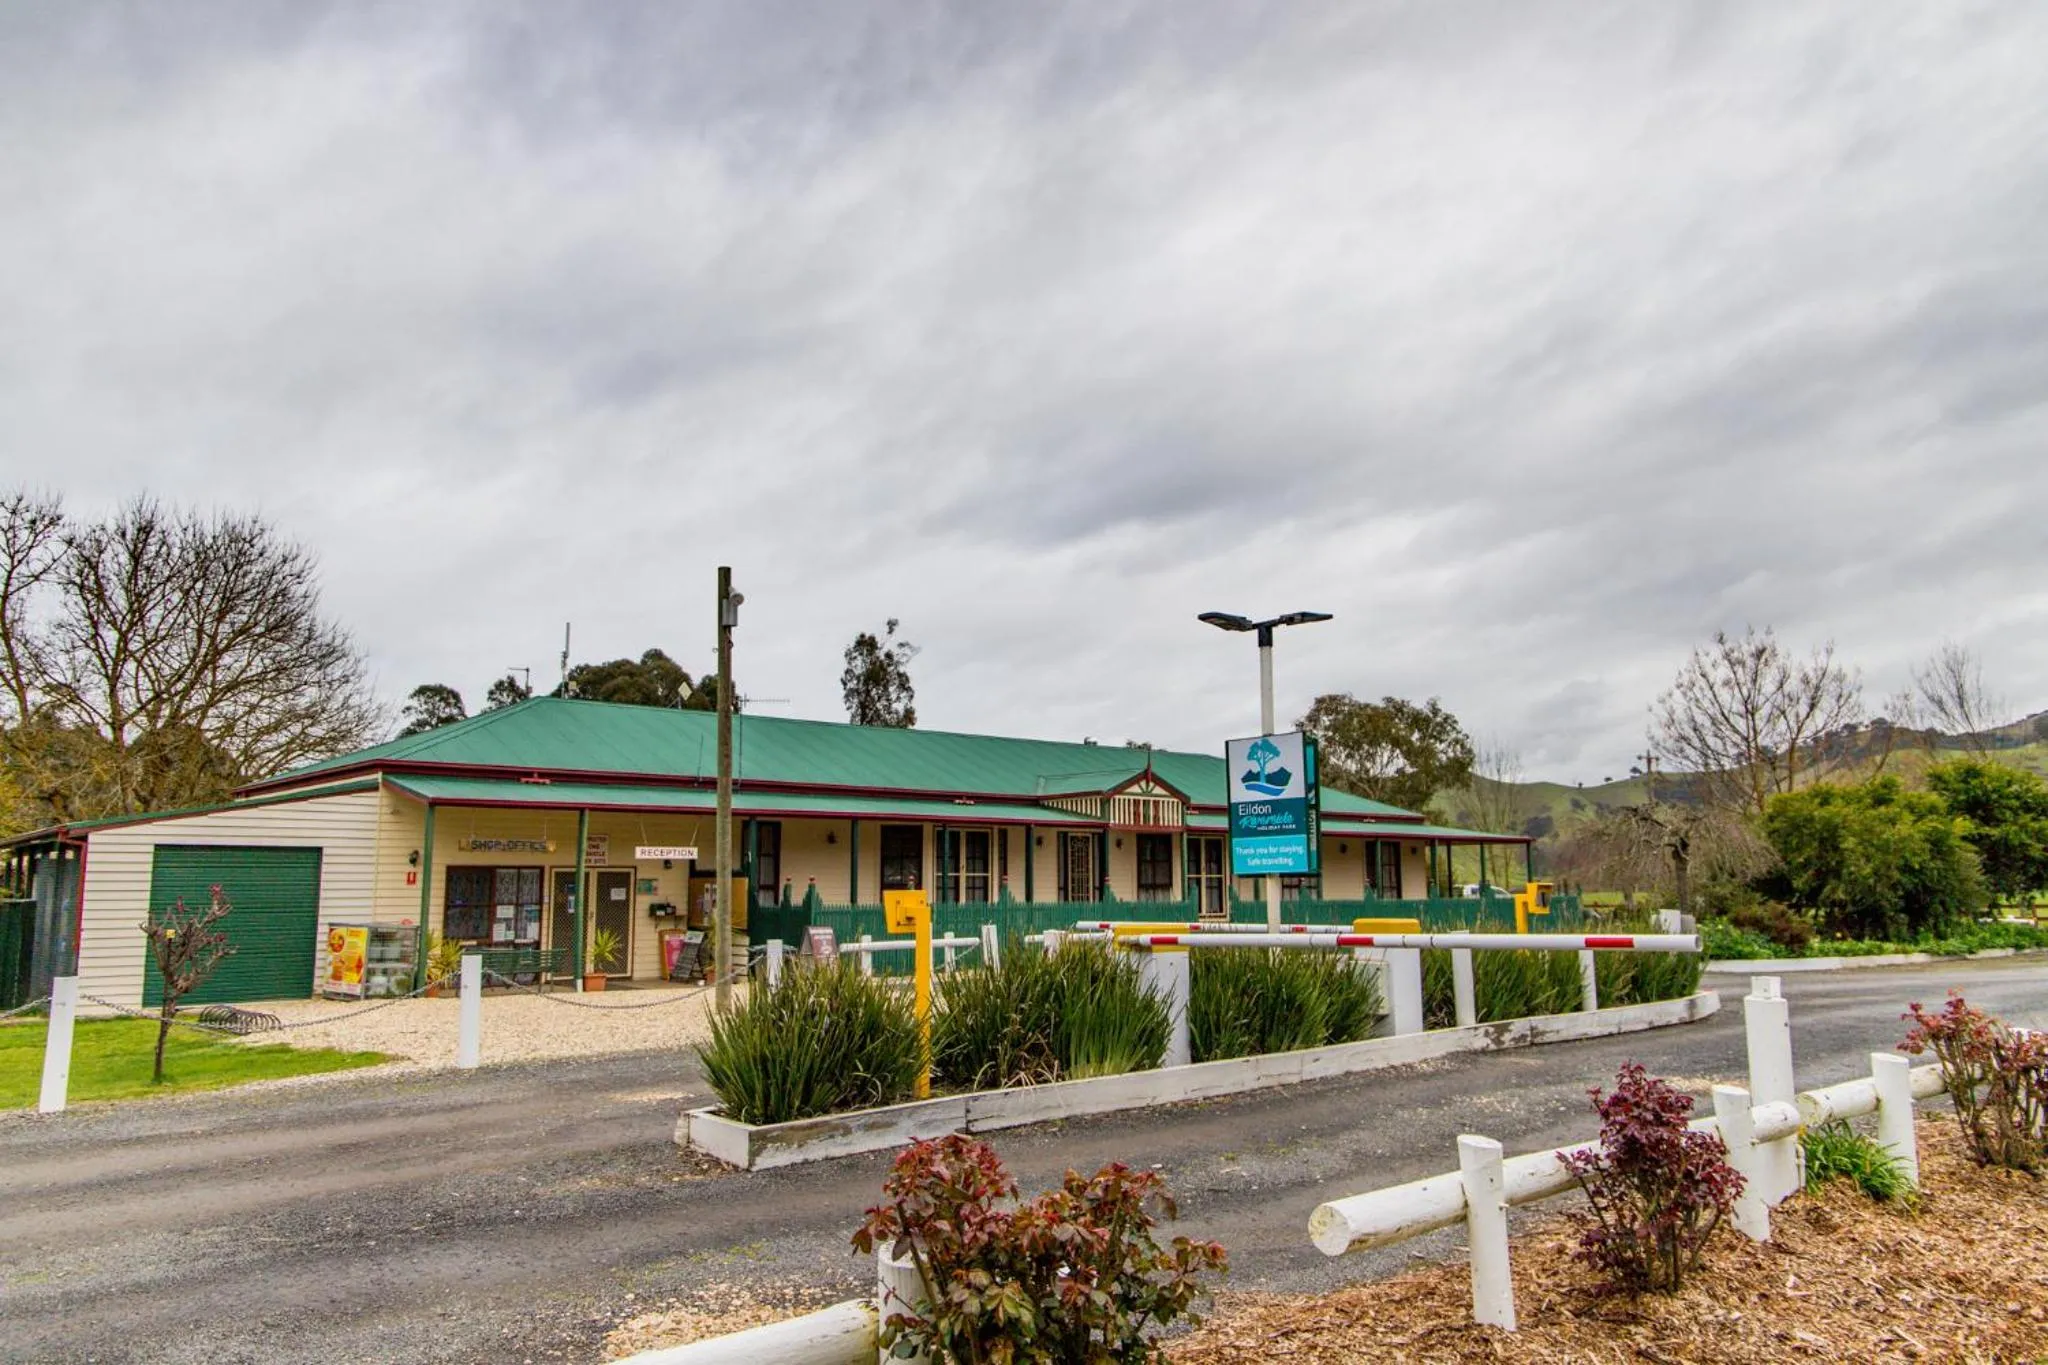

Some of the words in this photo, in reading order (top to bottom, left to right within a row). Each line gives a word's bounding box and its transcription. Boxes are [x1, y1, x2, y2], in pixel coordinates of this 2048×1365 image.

[1239, 804, 1271, 815] Eildon
[640, 848, 694, 857] RECEPTION
[1236, 847, 1254, 856] Thank
[1256, 847, 1268, 856] you
[1269, 844, 1279, 854] for
